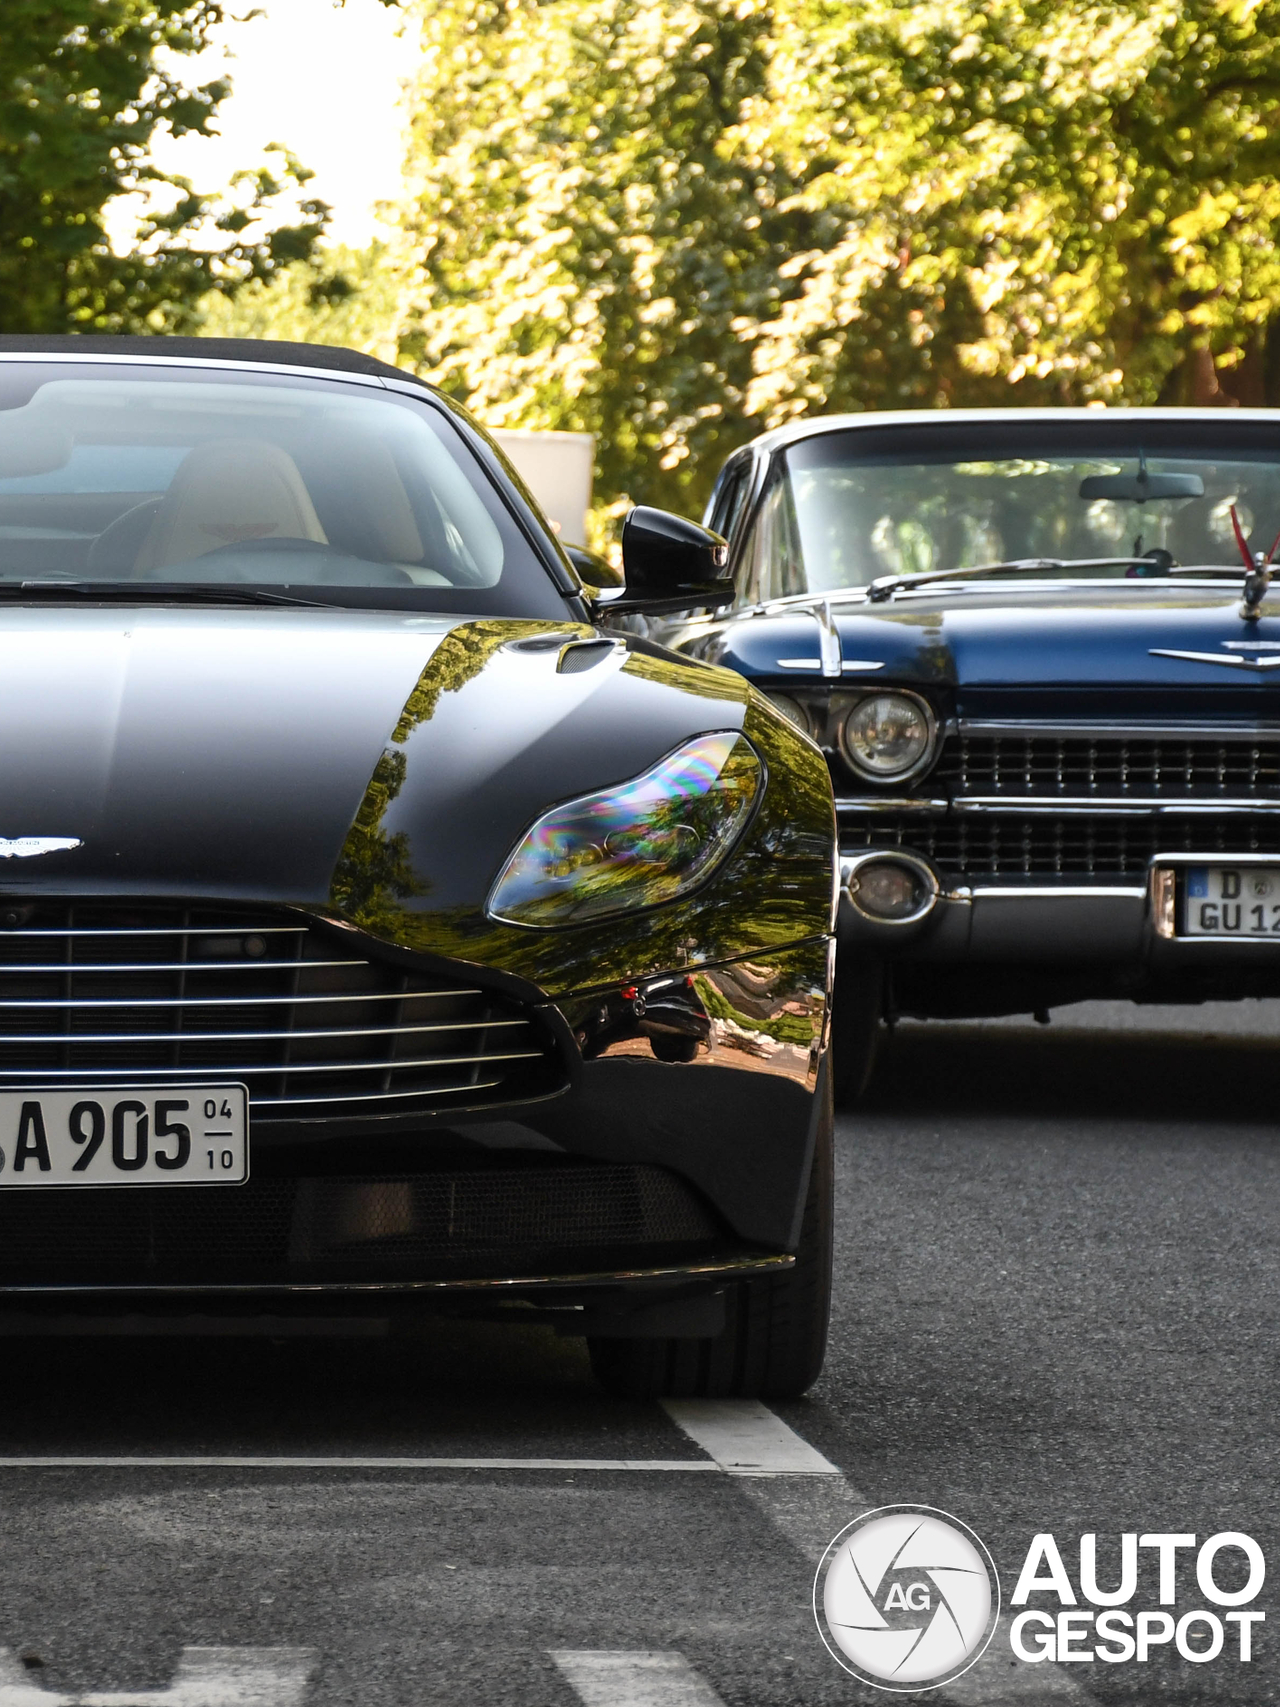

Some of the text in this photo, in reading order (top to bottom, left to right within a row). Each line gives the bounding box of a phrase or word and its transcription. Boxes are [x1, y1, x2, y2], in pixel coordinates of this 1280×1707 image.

[1221, 871, 1241, 899] D
[1200, 904, 1242, 931] GU
[203, 1099, 233, 1120] 04
[13, 1101, 51, 1172] A
[68, 1099, 191, 1172] 905
[207, 1149, 233, 1170] 10
